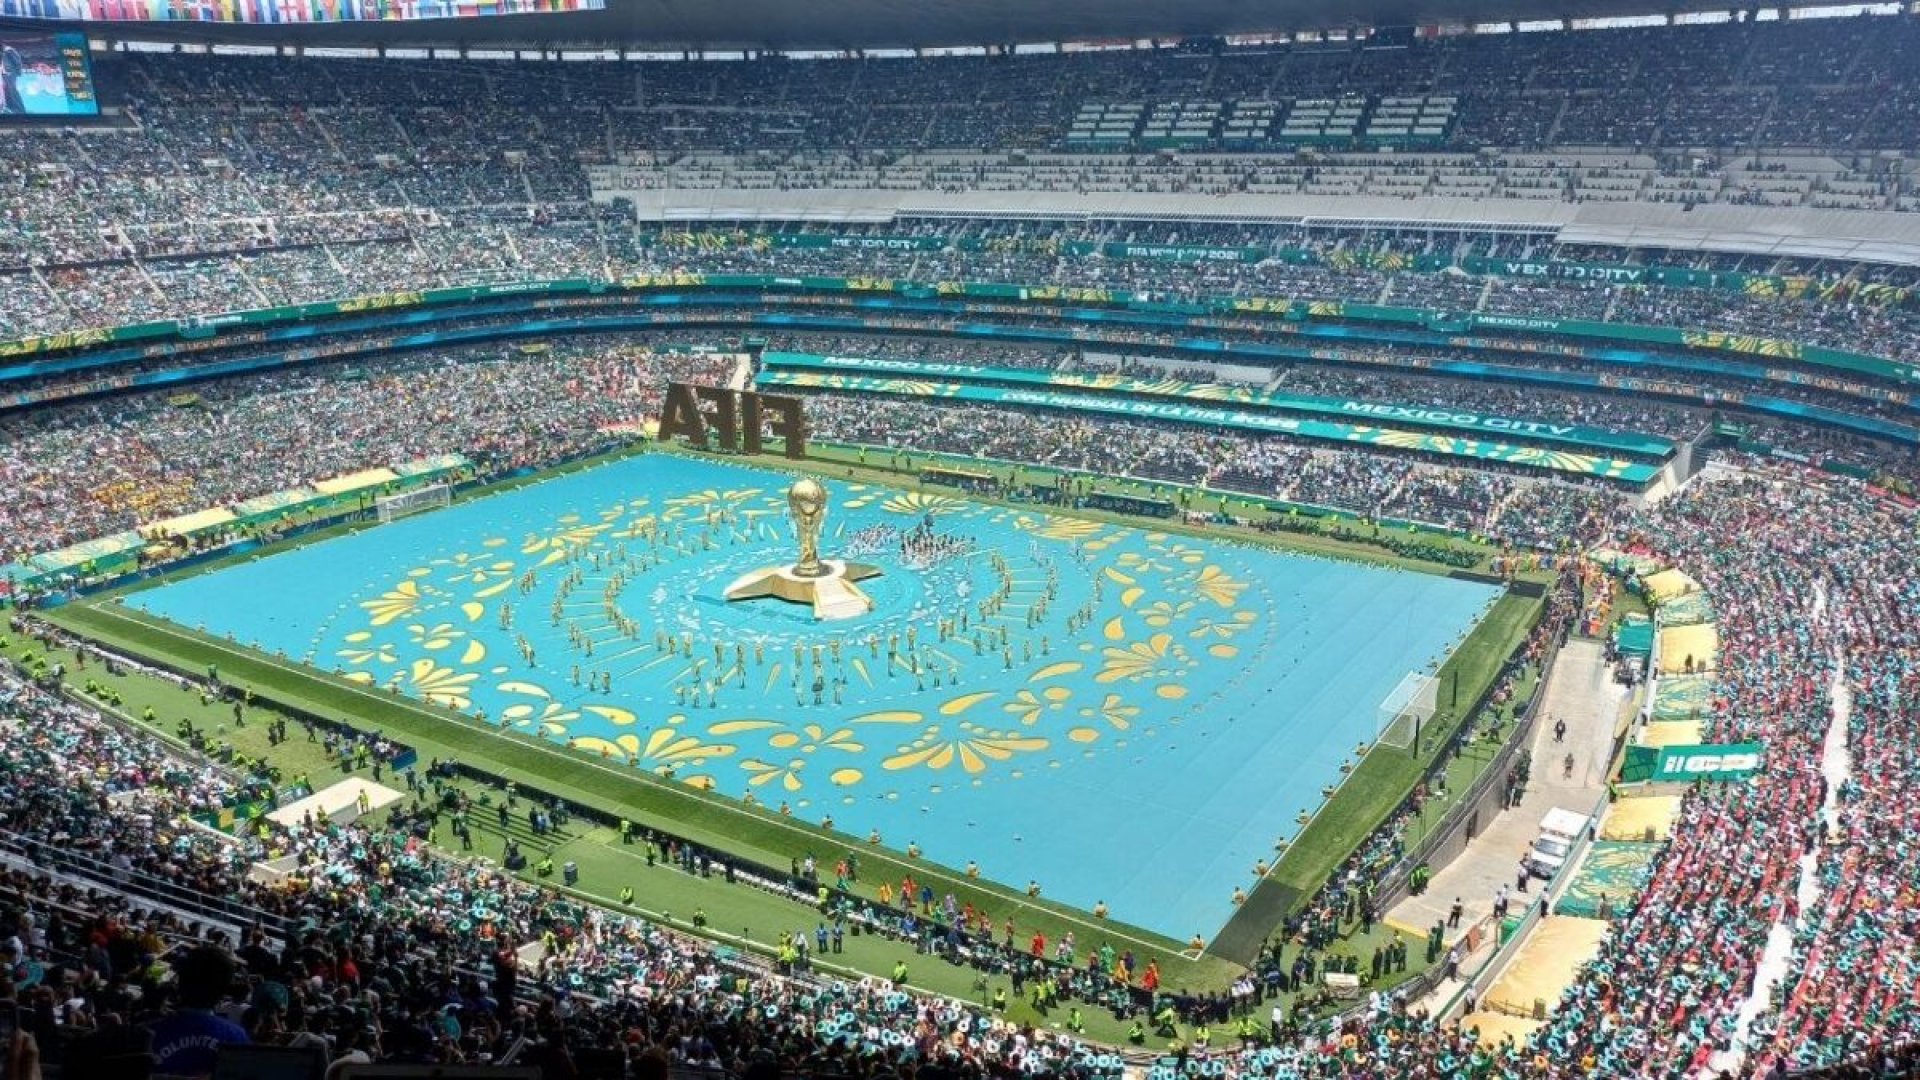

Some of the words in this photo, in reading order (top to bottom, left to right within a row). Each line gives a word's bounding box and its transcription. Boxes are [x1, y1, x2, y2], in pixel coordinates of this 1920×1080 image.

[888, 239, 920, 250] CITY
[1478, 316, 1527, 326] MEXICO
[1529, 320, 1560, 329] CITY
[823, 356, 921, 369] MEXICO
[924, 365, 984, 373] CITY
[1343, 402, 1478, 424] MEXICO
[1484, 418, 1576, 435] CITY
